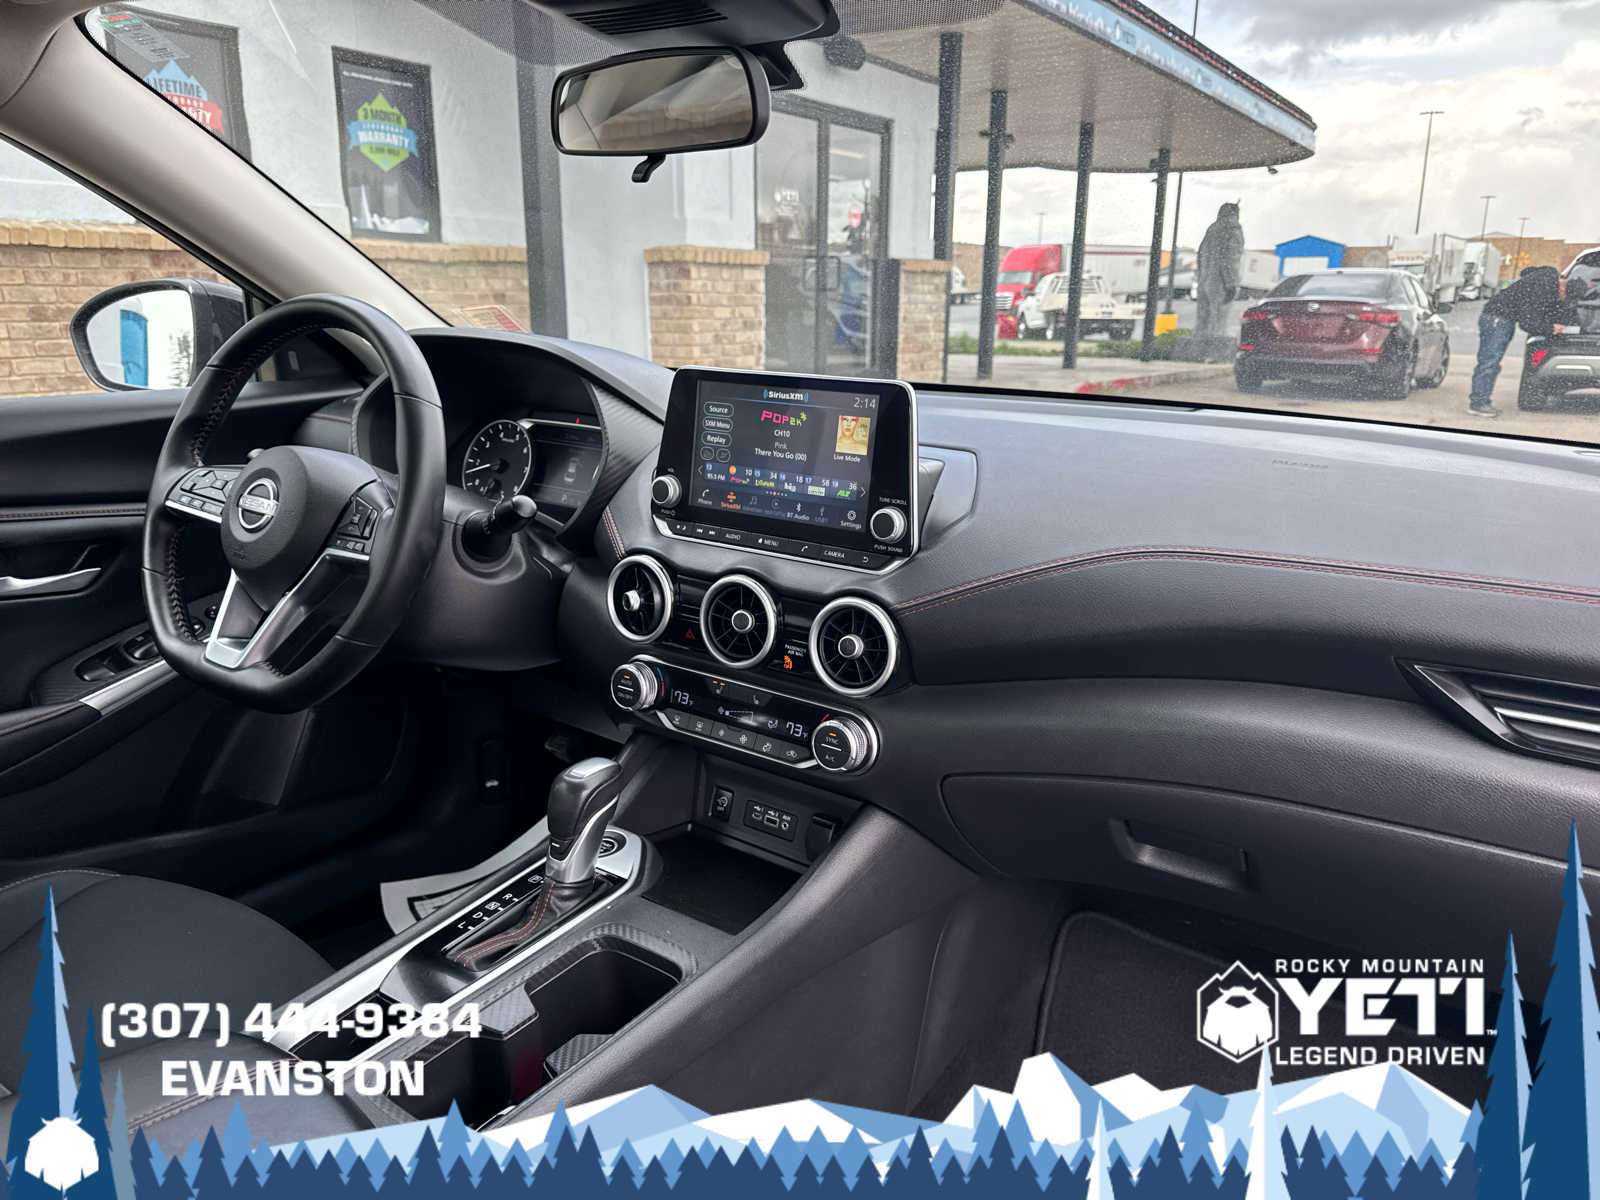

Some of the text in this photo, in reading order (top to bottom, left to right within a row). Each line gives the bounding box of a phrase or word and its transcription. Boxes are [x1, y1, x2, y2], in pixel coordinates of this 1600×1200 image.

[853, 397, 876, 409] 2:14
[709, 405, 729, 414] Source
[774, 429, 791, 438] CH10
[706, 434, 726, 445] Replay
[755, 448, 771, 457] There
[773, 450, 785, 459] You
[785, 452, 794, 460] Go
[845, 455, 861, 463] Mode
[840, 520, 862, 530] Settings
[824, 550, 845, 559] CAMERA
[674, 690, 689, 705] 73
[786, 721, 803, 737] 73
[502, 893, 512, 901] R
[472, 911, 483, 919] D
[457, 921, 466, 929] L
